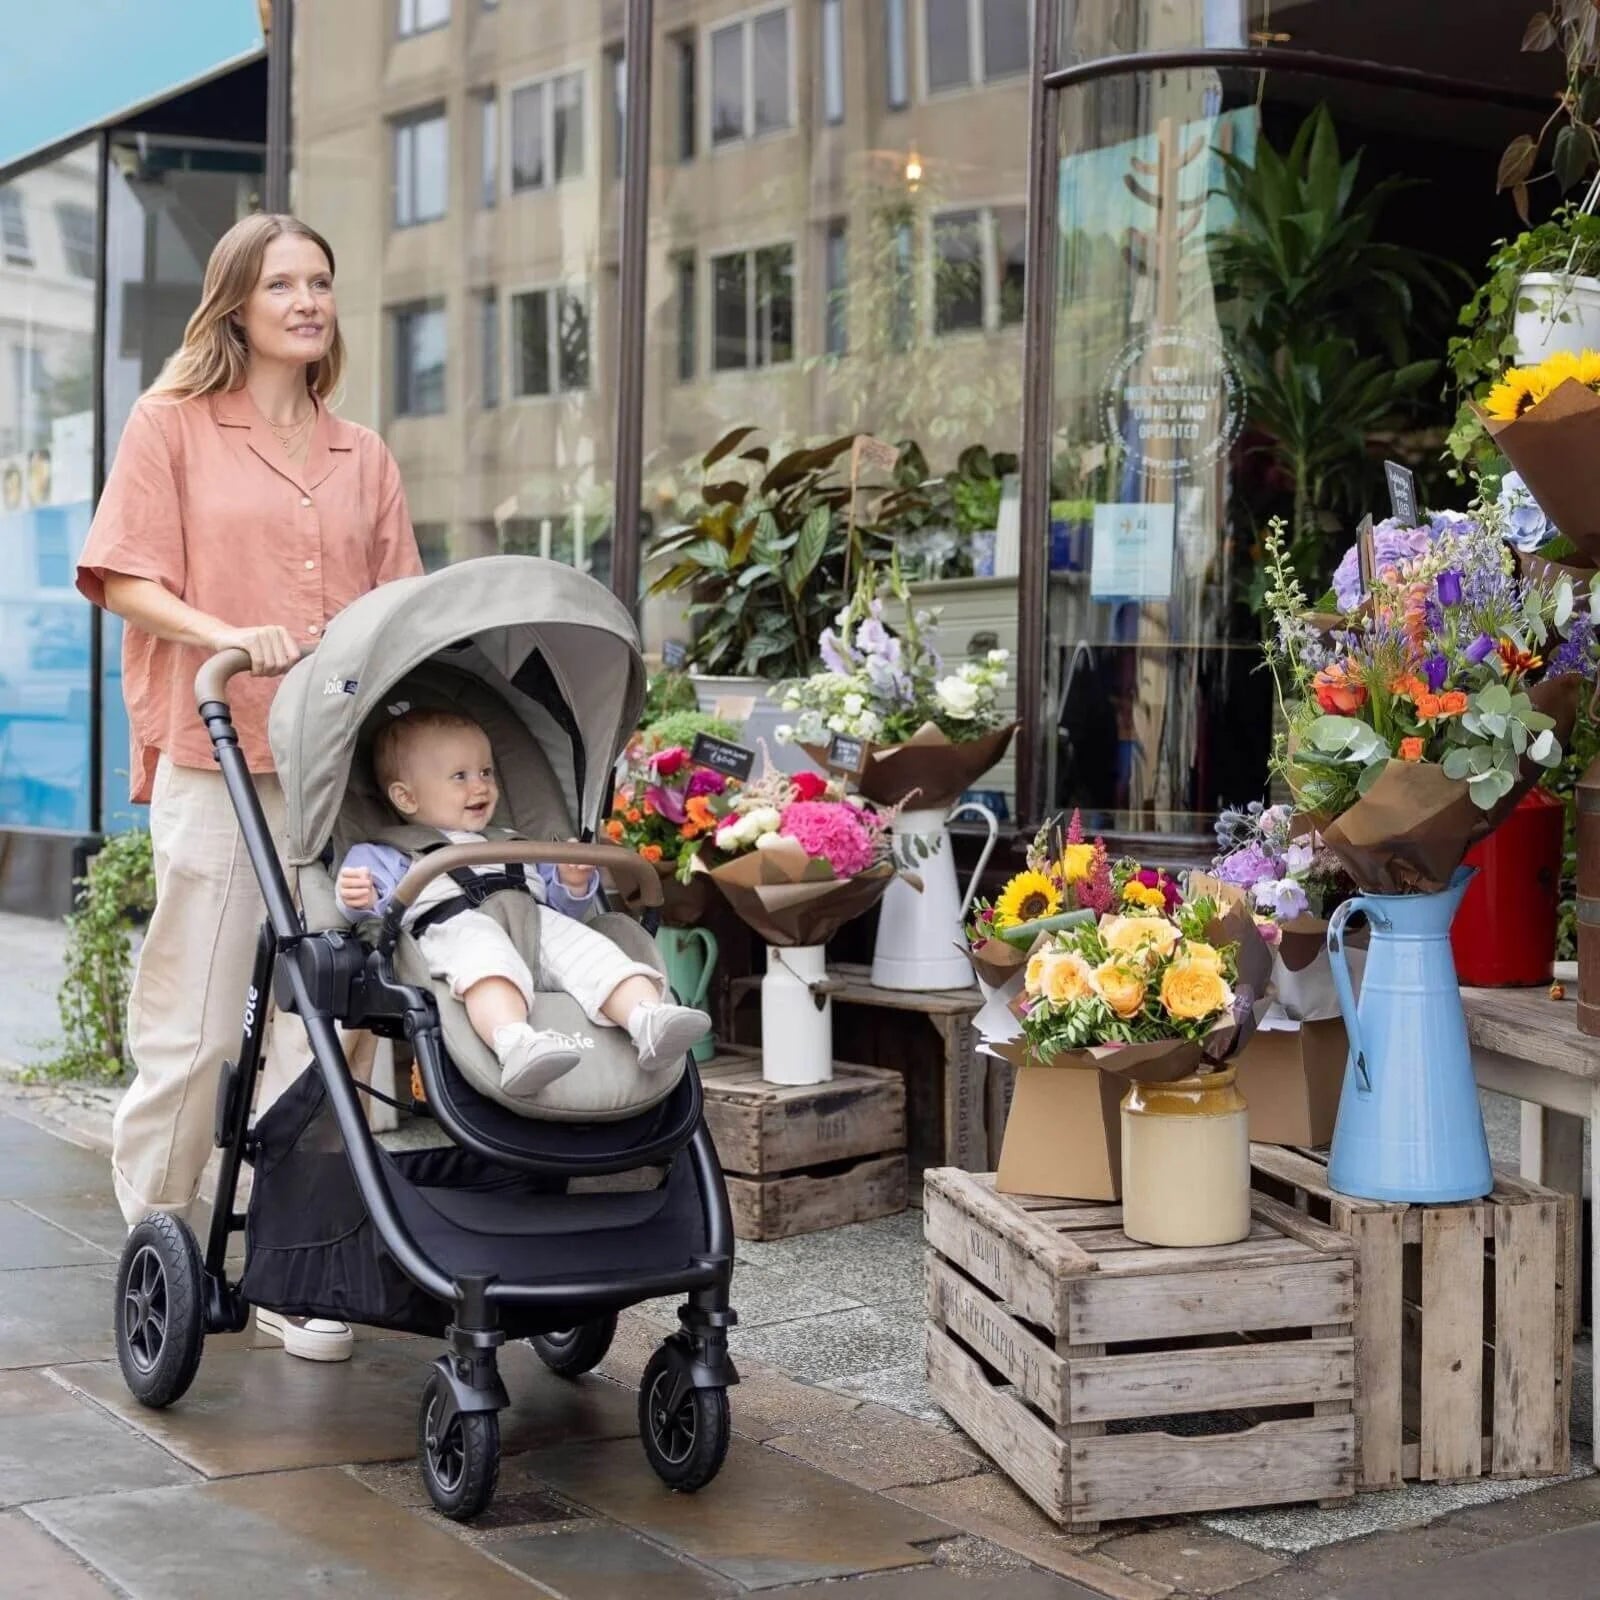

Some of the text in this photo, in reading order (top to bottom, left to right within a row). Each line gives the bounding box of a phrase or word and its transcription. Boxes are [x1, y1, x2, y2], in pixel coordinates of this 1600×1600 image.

[1133, 405, 1206, 420] OWNED AND
[1138, 424, 1200, 439] OPERATED
[243, 985, 258, 1038] Joie
